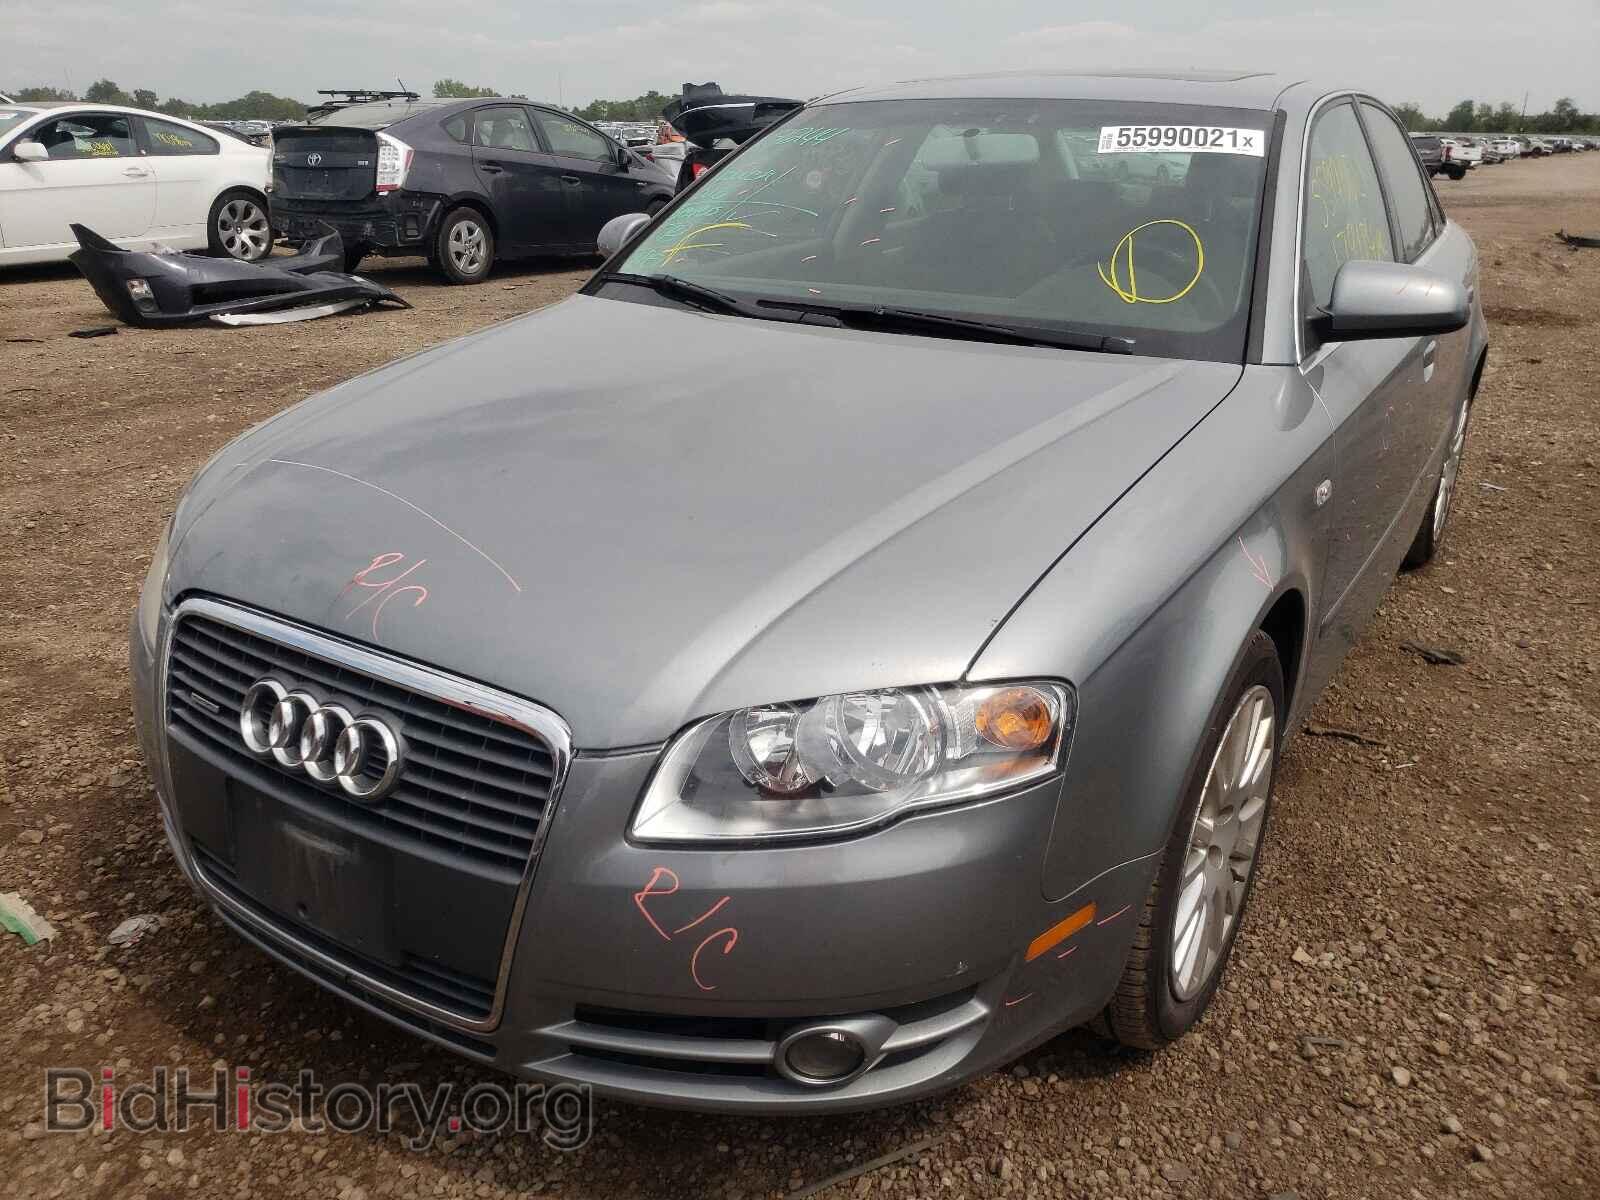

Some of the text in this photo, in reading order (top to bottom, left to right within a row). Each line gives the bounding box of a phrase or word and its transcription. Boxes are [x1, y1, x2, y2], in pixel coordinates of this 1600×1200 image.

[1116, 127, 1239, 148] 55990021
[340, 552, 429, 641] R/C
[633, 866, 739, 991] R/C
